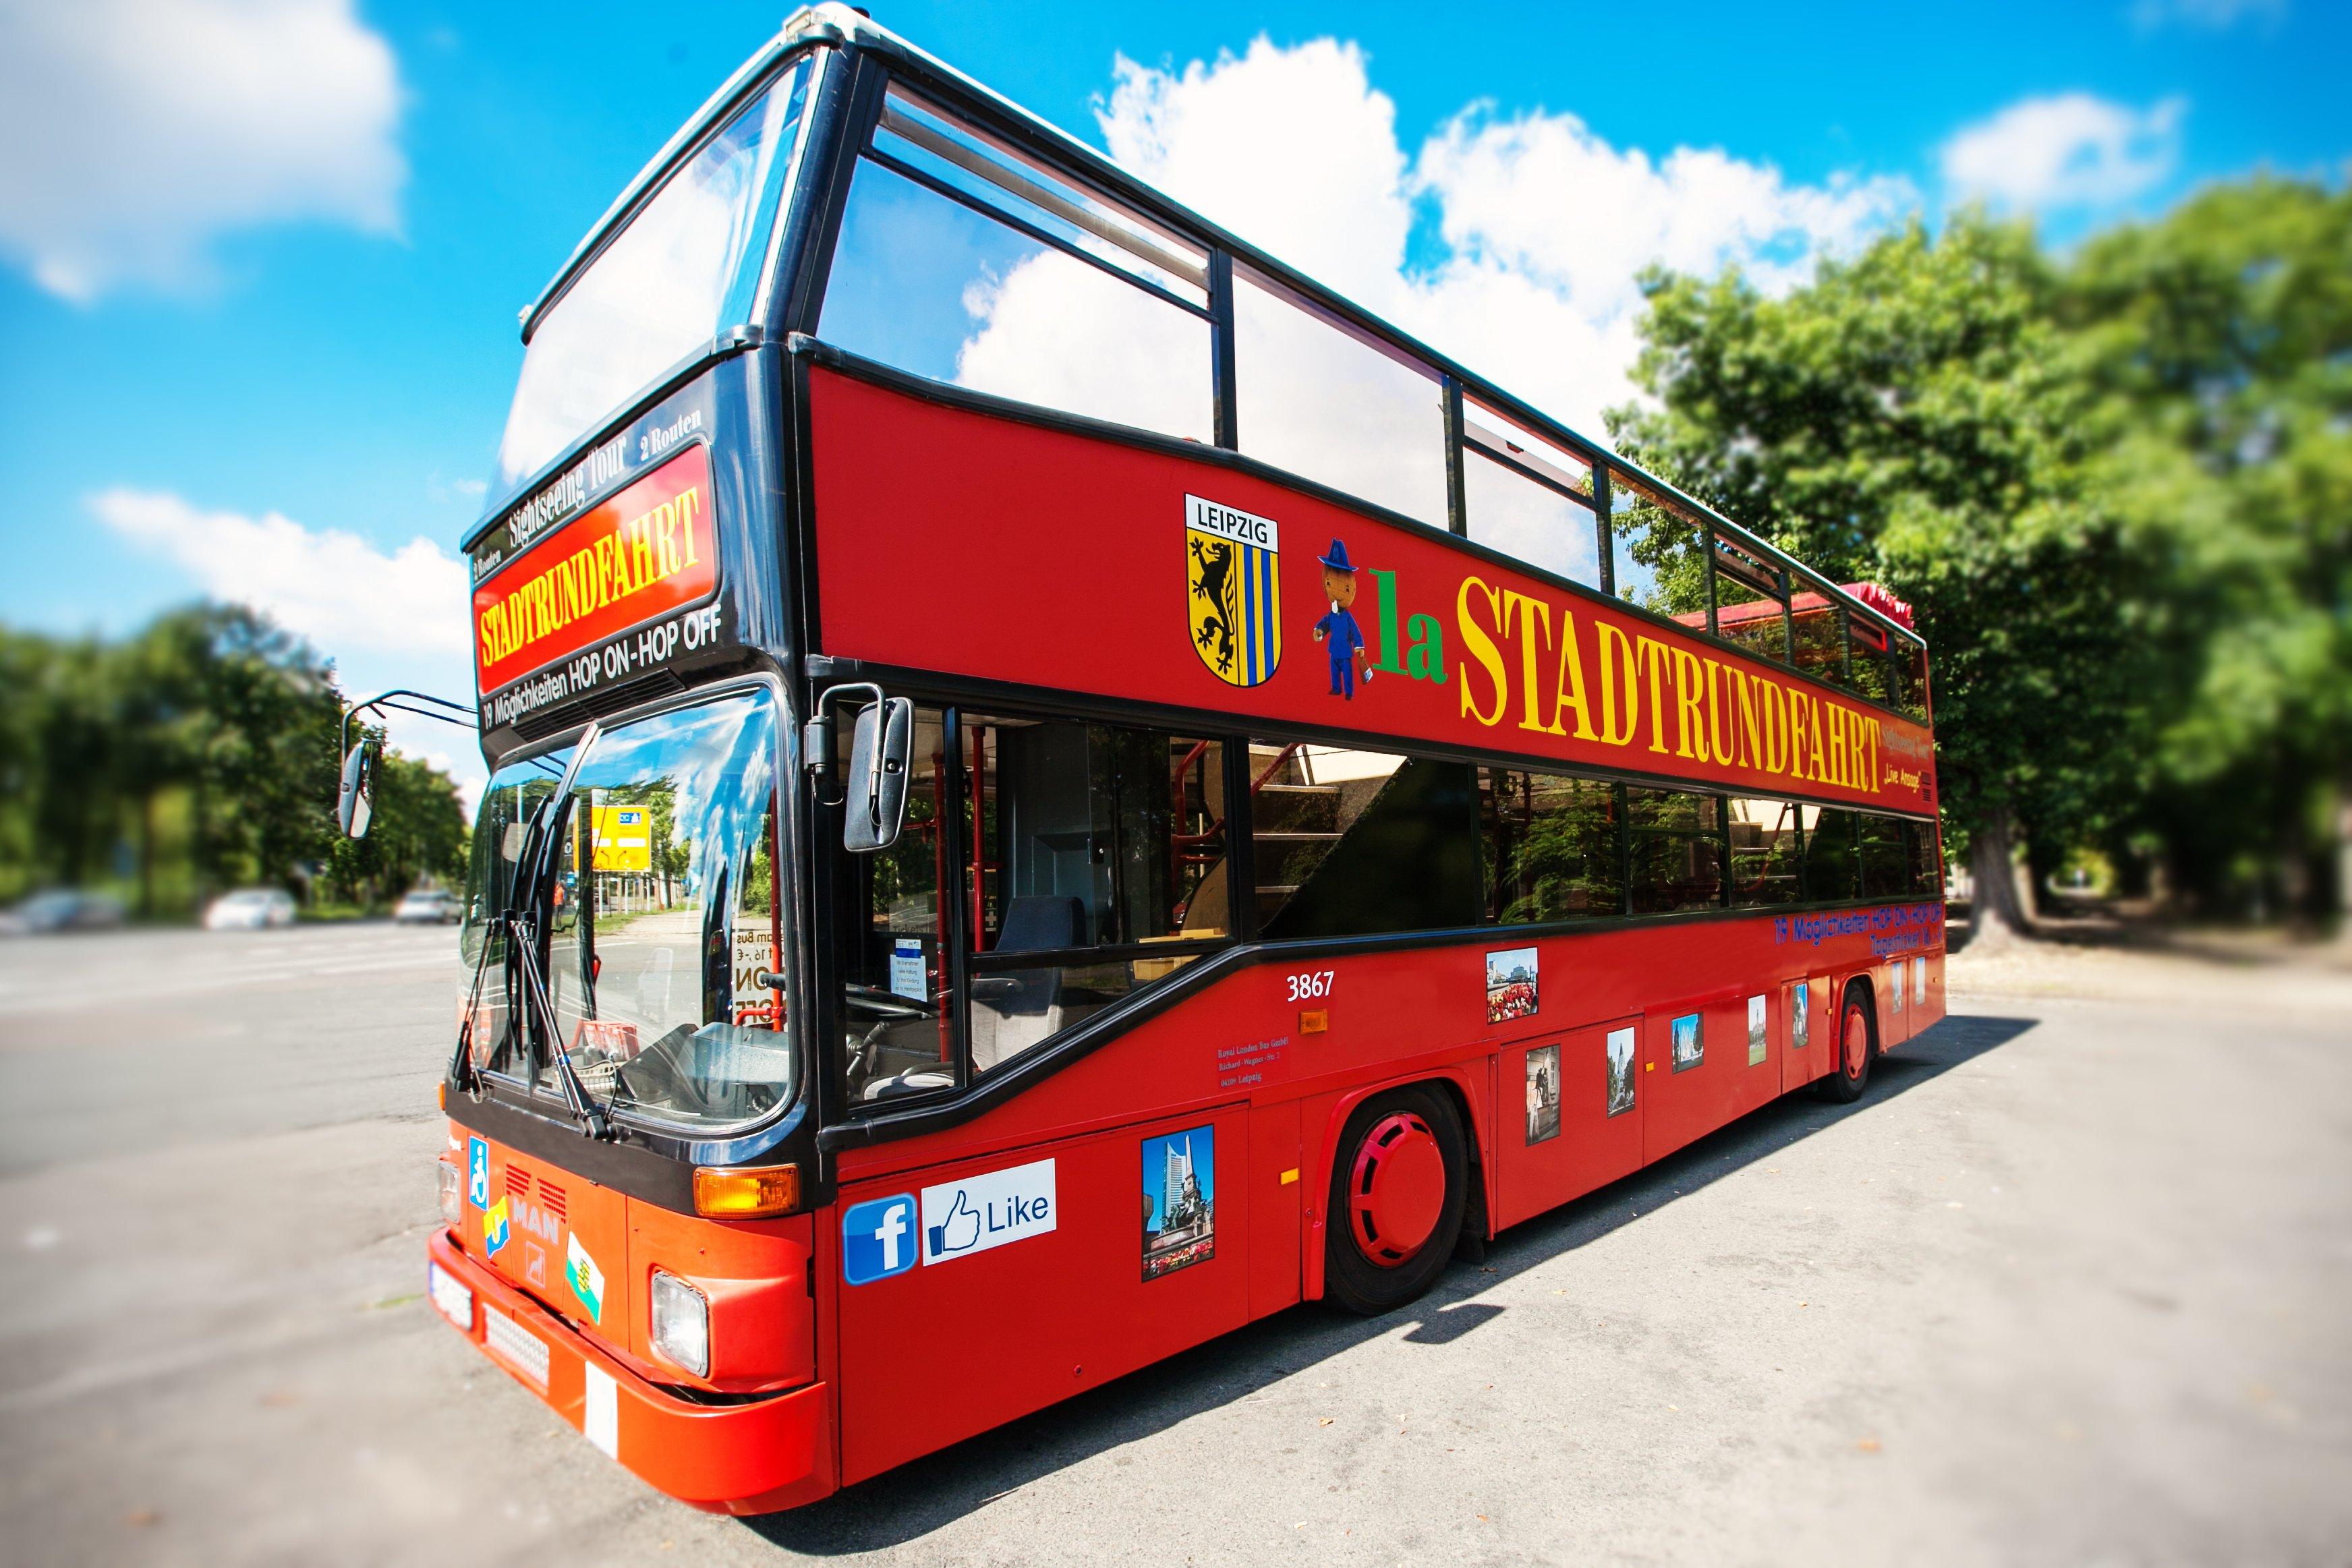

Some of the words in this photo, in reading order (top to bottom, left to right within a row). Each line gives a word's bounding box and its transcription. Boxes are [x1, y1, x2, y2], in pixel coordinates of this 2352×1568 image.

[640, 436, 649, 461] 2
[650, 409, 702, 453] Routen
[509, 462, 585, 548] Sightseeing
[587, 436, 627, 490] Tour
[1197, 502, 1268, 545] LEIPZIG
[480, 486, 699, 668] STADTRUNDFAHRT
[1369, 568, 1448, 685] la
[483, 702, 492, 730] 19
[494, 672, 568, 724] Möglichkeiten
[569, 658, 601, 693] HOP
[683, 604, 722, 650] OFF
[1457, 575, 1881, 794] STADTRUNDFAHRT
[1774, 917, 1787, 945] 19
[1792, 912, 1869, 946] Möglichkeiten
[1871, 907, 1891, 930] HOP
[1286, 970, 1335, 1002] 3867
[1217, 1047, 1236, 1059] Royal
[1236, 1043, 1259, 1055] London
[1259, 1041, 1269, 1049] Bus
[1270, 1035, 1289, 1048] GmbH
[1238, 1071, 1263, 1084] Leipzig
[512, 1196, 559, 1246] MAN
[987, 1194, 1049, 1234] Like
